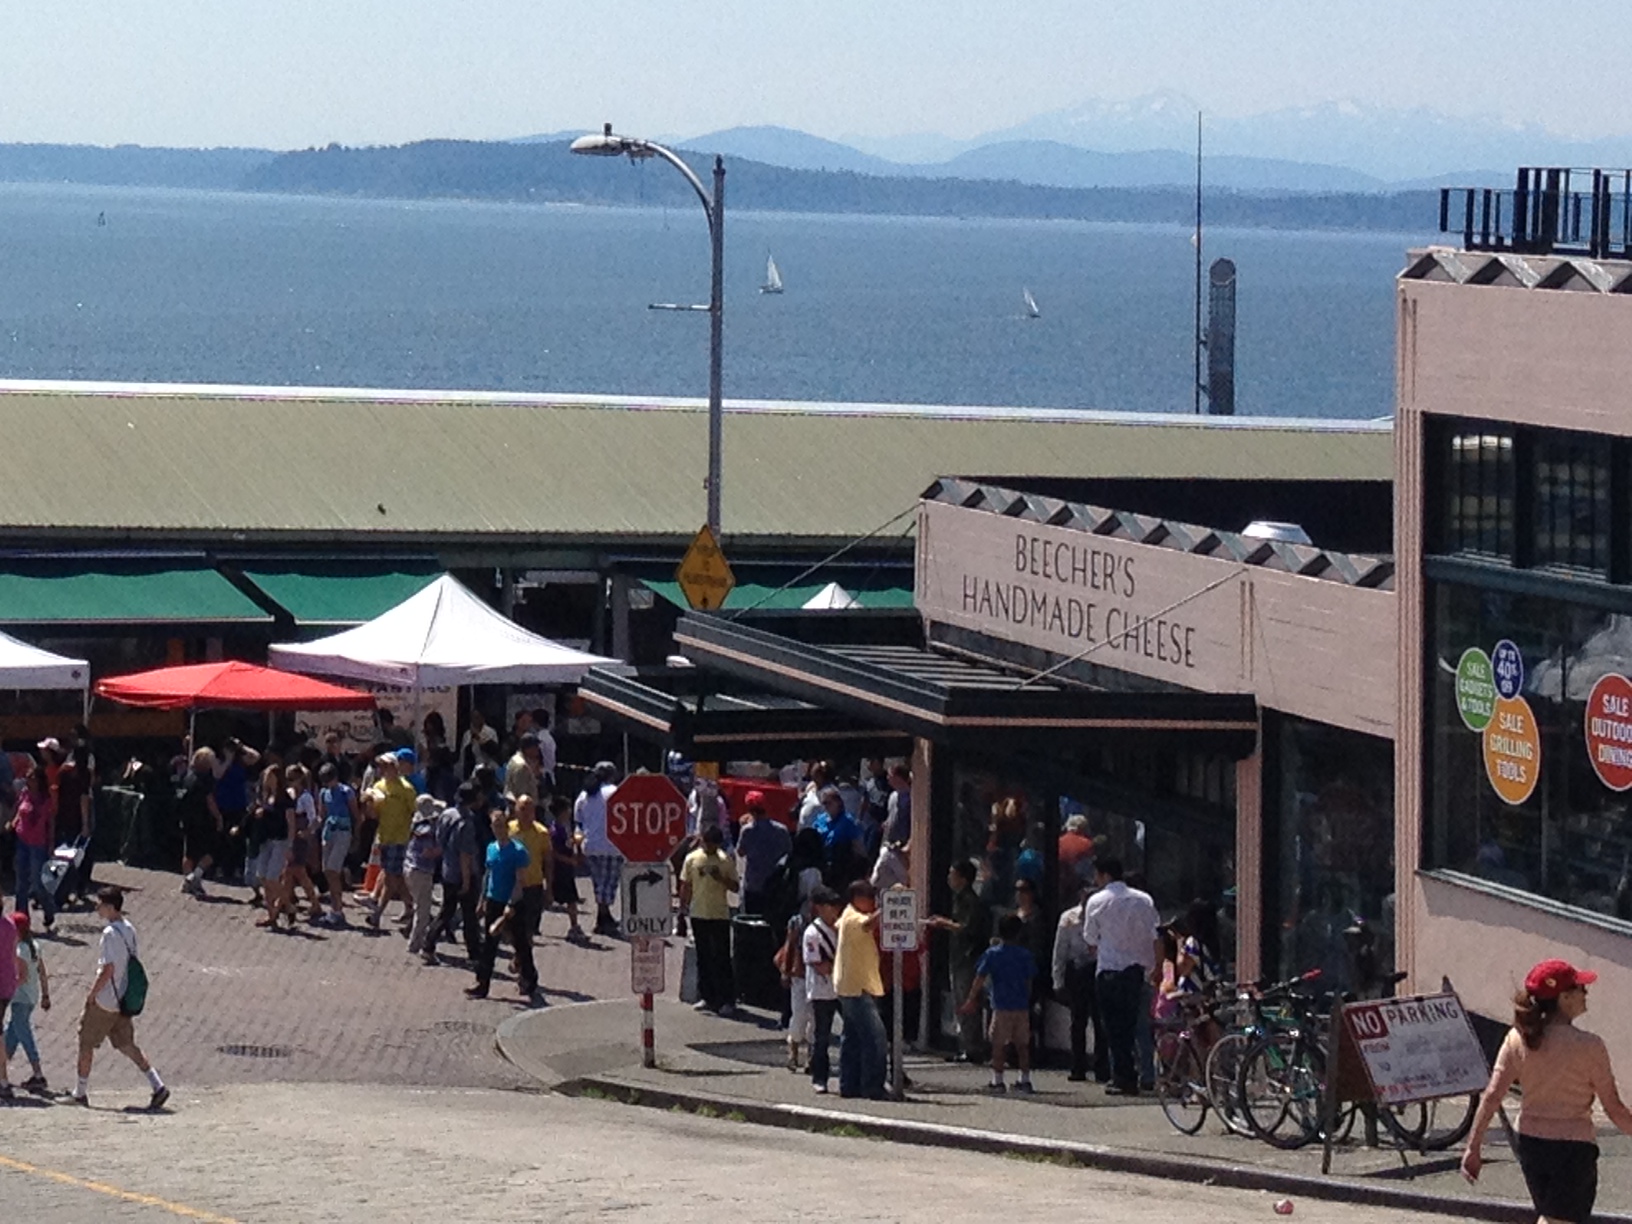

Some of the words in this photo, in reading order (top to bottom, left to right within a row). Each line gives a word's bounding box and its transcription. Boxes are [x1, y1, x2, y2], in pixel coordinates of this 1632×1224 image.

[1015, 533, 1136, 598] BEECHER'S
[962, 573, 1097, 644] HANDMADE
[1105, 607, 1196, 669] CHEESE
[1467, 661, 1486, 680] SALE
[1602, 694, 1629, 717] SALE
[1499, 711, 1525, 734] SALE
[1489, 733, 1534, 761] GRILLING
[1496, 758, 1527, 784] TOOLS
[611, 802, 681, 835] STOP
[627, 918, 668, 934] ONLY
[1351, 1010, 1382, 1036] NO
[1387, 1002, 1458, 1025] PARKING
